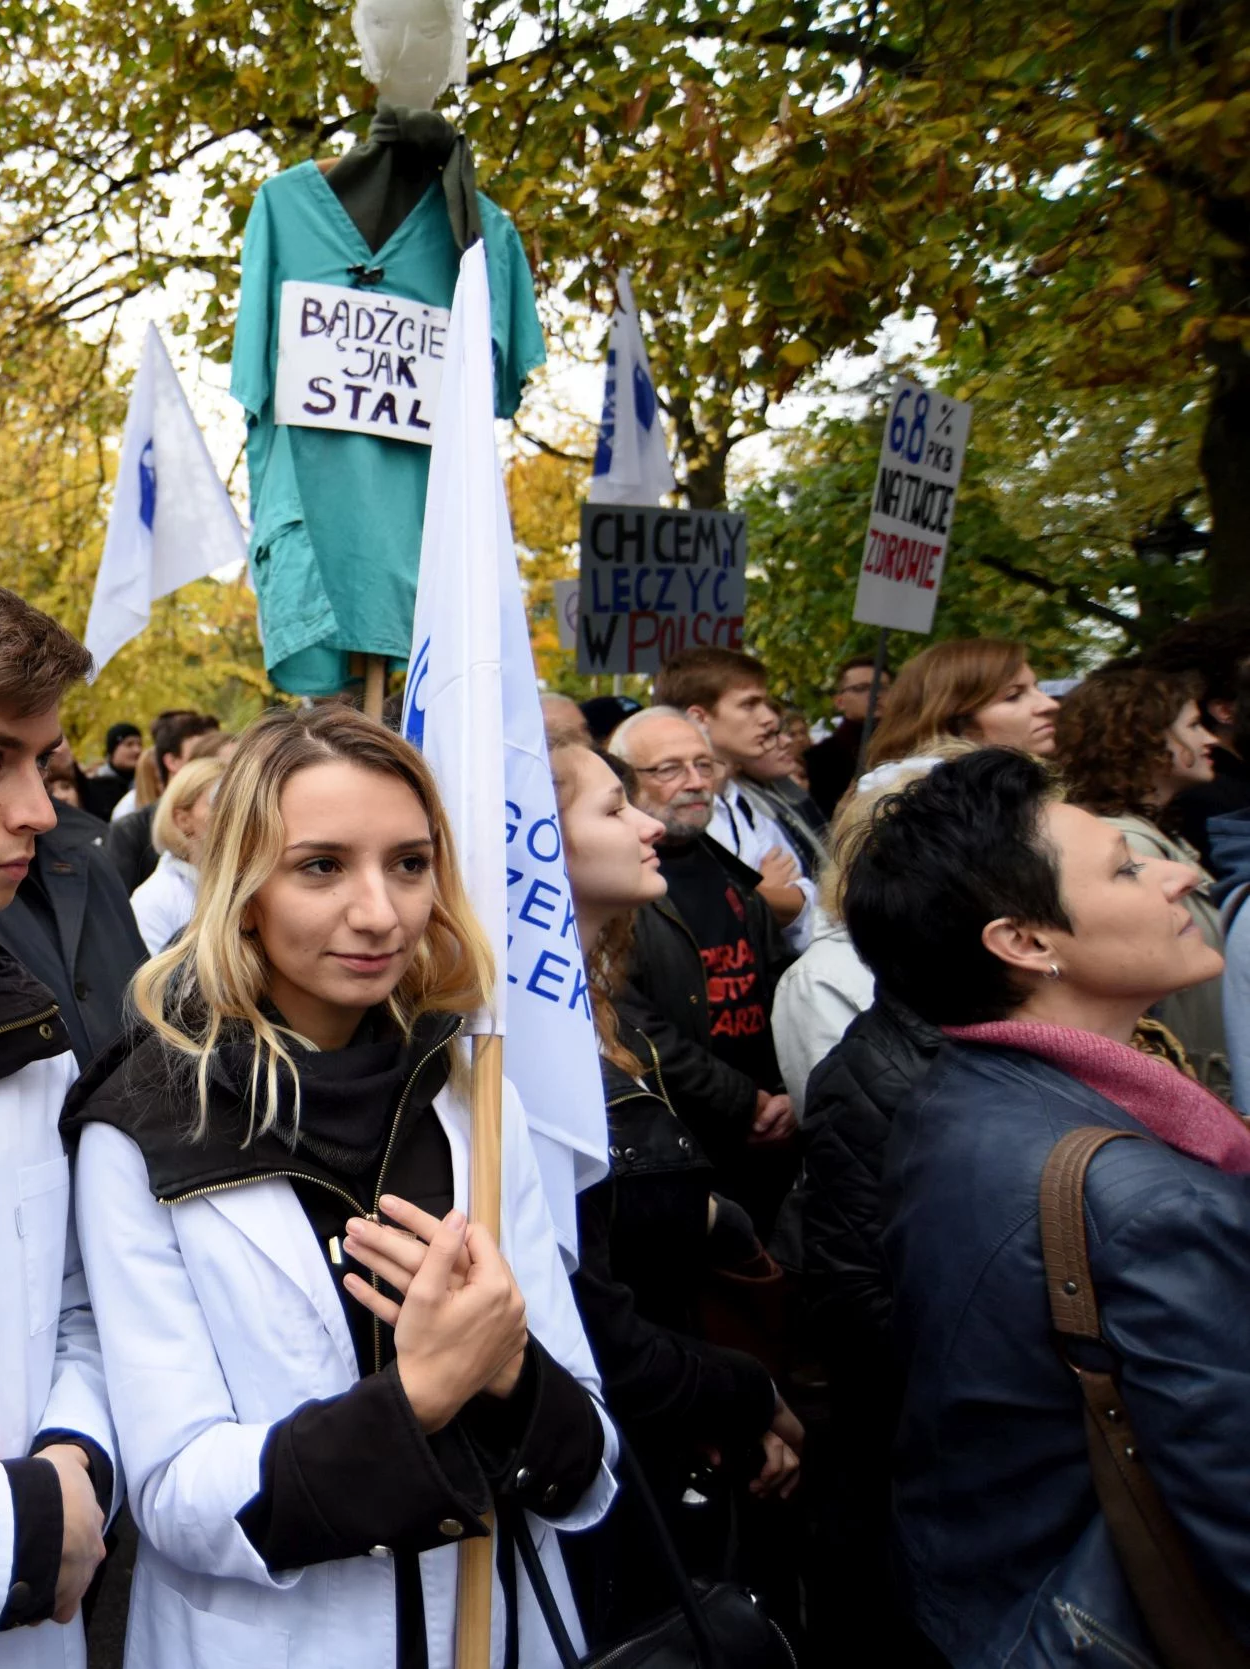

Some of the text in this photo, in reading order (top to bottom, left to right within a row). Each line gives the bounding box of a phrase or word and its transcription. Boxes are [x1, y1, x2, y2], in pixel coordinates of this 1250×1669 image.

[342, 346, 417, 389] JAK
[302, 376, 431, 431] STAL
[924, 440, 953, 474] PKB
[591, 513, 744, 567] CHCEMY
[864, 528, 942, 590] ZDROWIE
[591, 548, 729, 613] LECZYĆ
[582, 614, 620, 668] W
